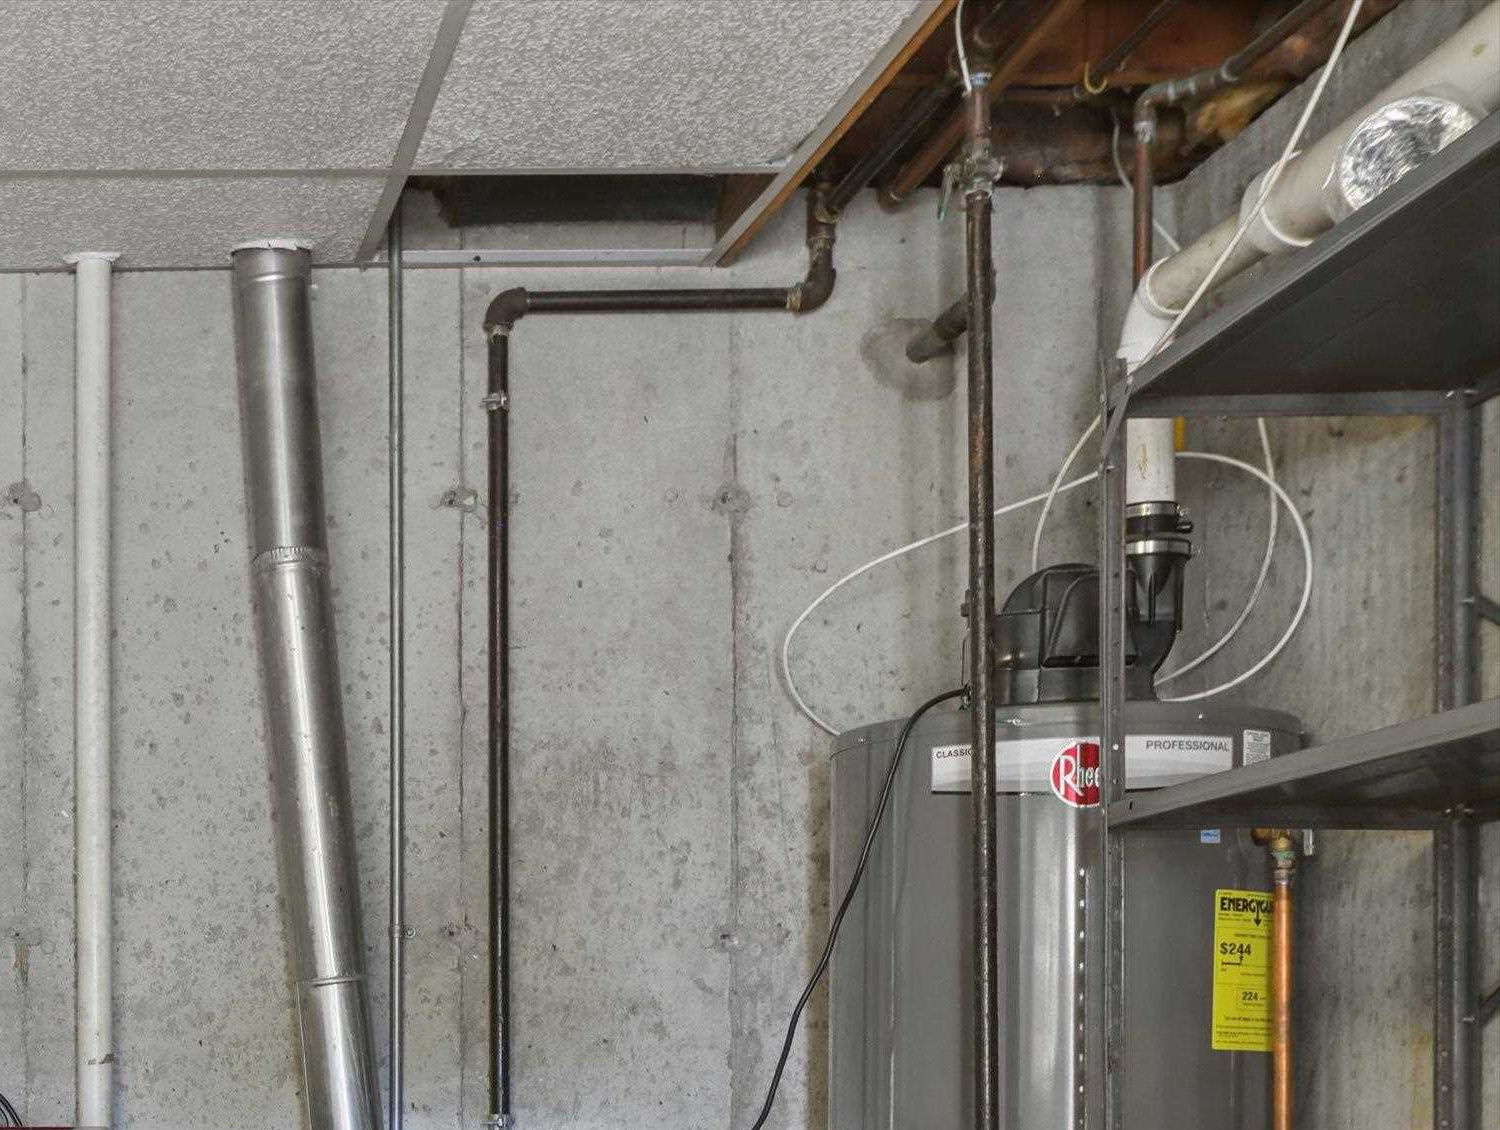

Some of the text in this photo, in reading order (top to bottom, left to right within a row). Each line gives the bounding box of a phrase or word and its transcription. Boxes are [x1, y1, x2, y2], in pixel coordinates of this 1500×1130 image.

[1146, 740, 1230, 752] PROFESSIONAL
[1060, 744, 1100, 796] Rhee
[1242, 991, 1258, 1001] 224
